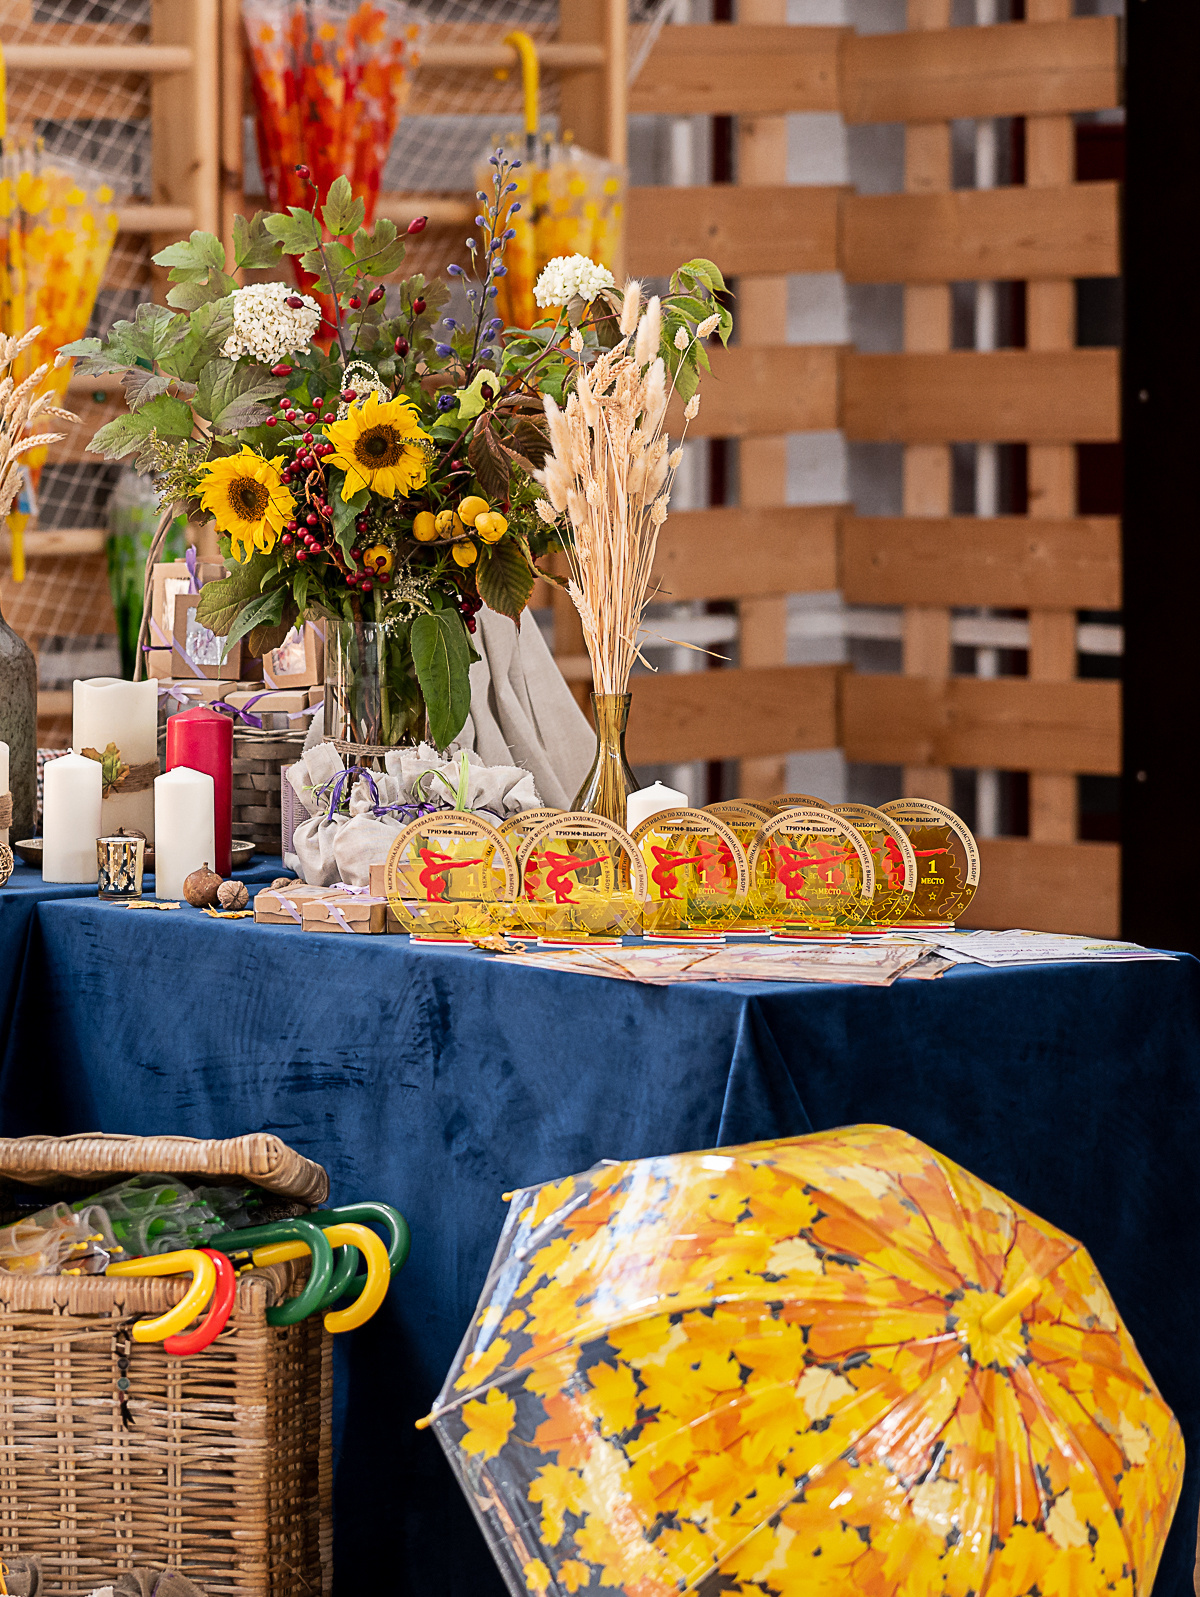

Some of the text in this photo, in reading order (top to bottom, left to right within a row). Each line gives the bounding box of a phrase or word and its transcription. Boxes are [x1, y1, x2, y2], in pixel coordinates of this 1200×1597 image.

[500, 815, 530, 833] ФЕСТИВАЛЬ
[905, 802, 954, 821] ХУДОЖЕСТВЕННОЙ
[953, 819, 975, 854] ГИМНАСТИКЕ
[639, 813, 667, 832] ФЕСТИВАЛЬ
[675, 811, 723, 832] ХУДОЖЕСТВЕННОЙ
[723, 829, 744, 864] ГИМНАСТИКЕ
[765, 814, 793, 832] ФЕСТИВАЛЬ
[802, 811, 849, 832] ХУДОЖЕСТВЕННОЙ
[849, 829, 870, 865] ГИМНАСТИКЕ
[842, 807, 890, 827] ХУДОЖЕСТВЕННОЙ
[890, 824, 911, 860] ГИМНАСТИКЕ
[534, 818, 563, 838] ФЕСТИВАЛЬ
[572, 816, 621, 836] ХУДОЖЕСТВЕННОЙ
[620, 833, 643, 870] ГИМНАСТИКЕ
[388, 835, 407, 890] МЕЖРЕГИОНАЛЬНЫЙ
[406, 817, 434, 836] ФЕСТИВАЛЬ
[444, 815, 492, 835] ХУДОЖЕСТВЕННОЙ
[492, 833, 513, 868] ГИМНАСТИКЕ
[928, 860, 937, 873] 1
[467, 873, 476, 887] 1
[699, 870, 708, 883] 1
[825, 870, 834, 884] 1
[921, 877, 944, 885] МЕСТО
[692, 887, 715, 895] МЕСТО
[818, 887, 841, 895] МЕСТО
